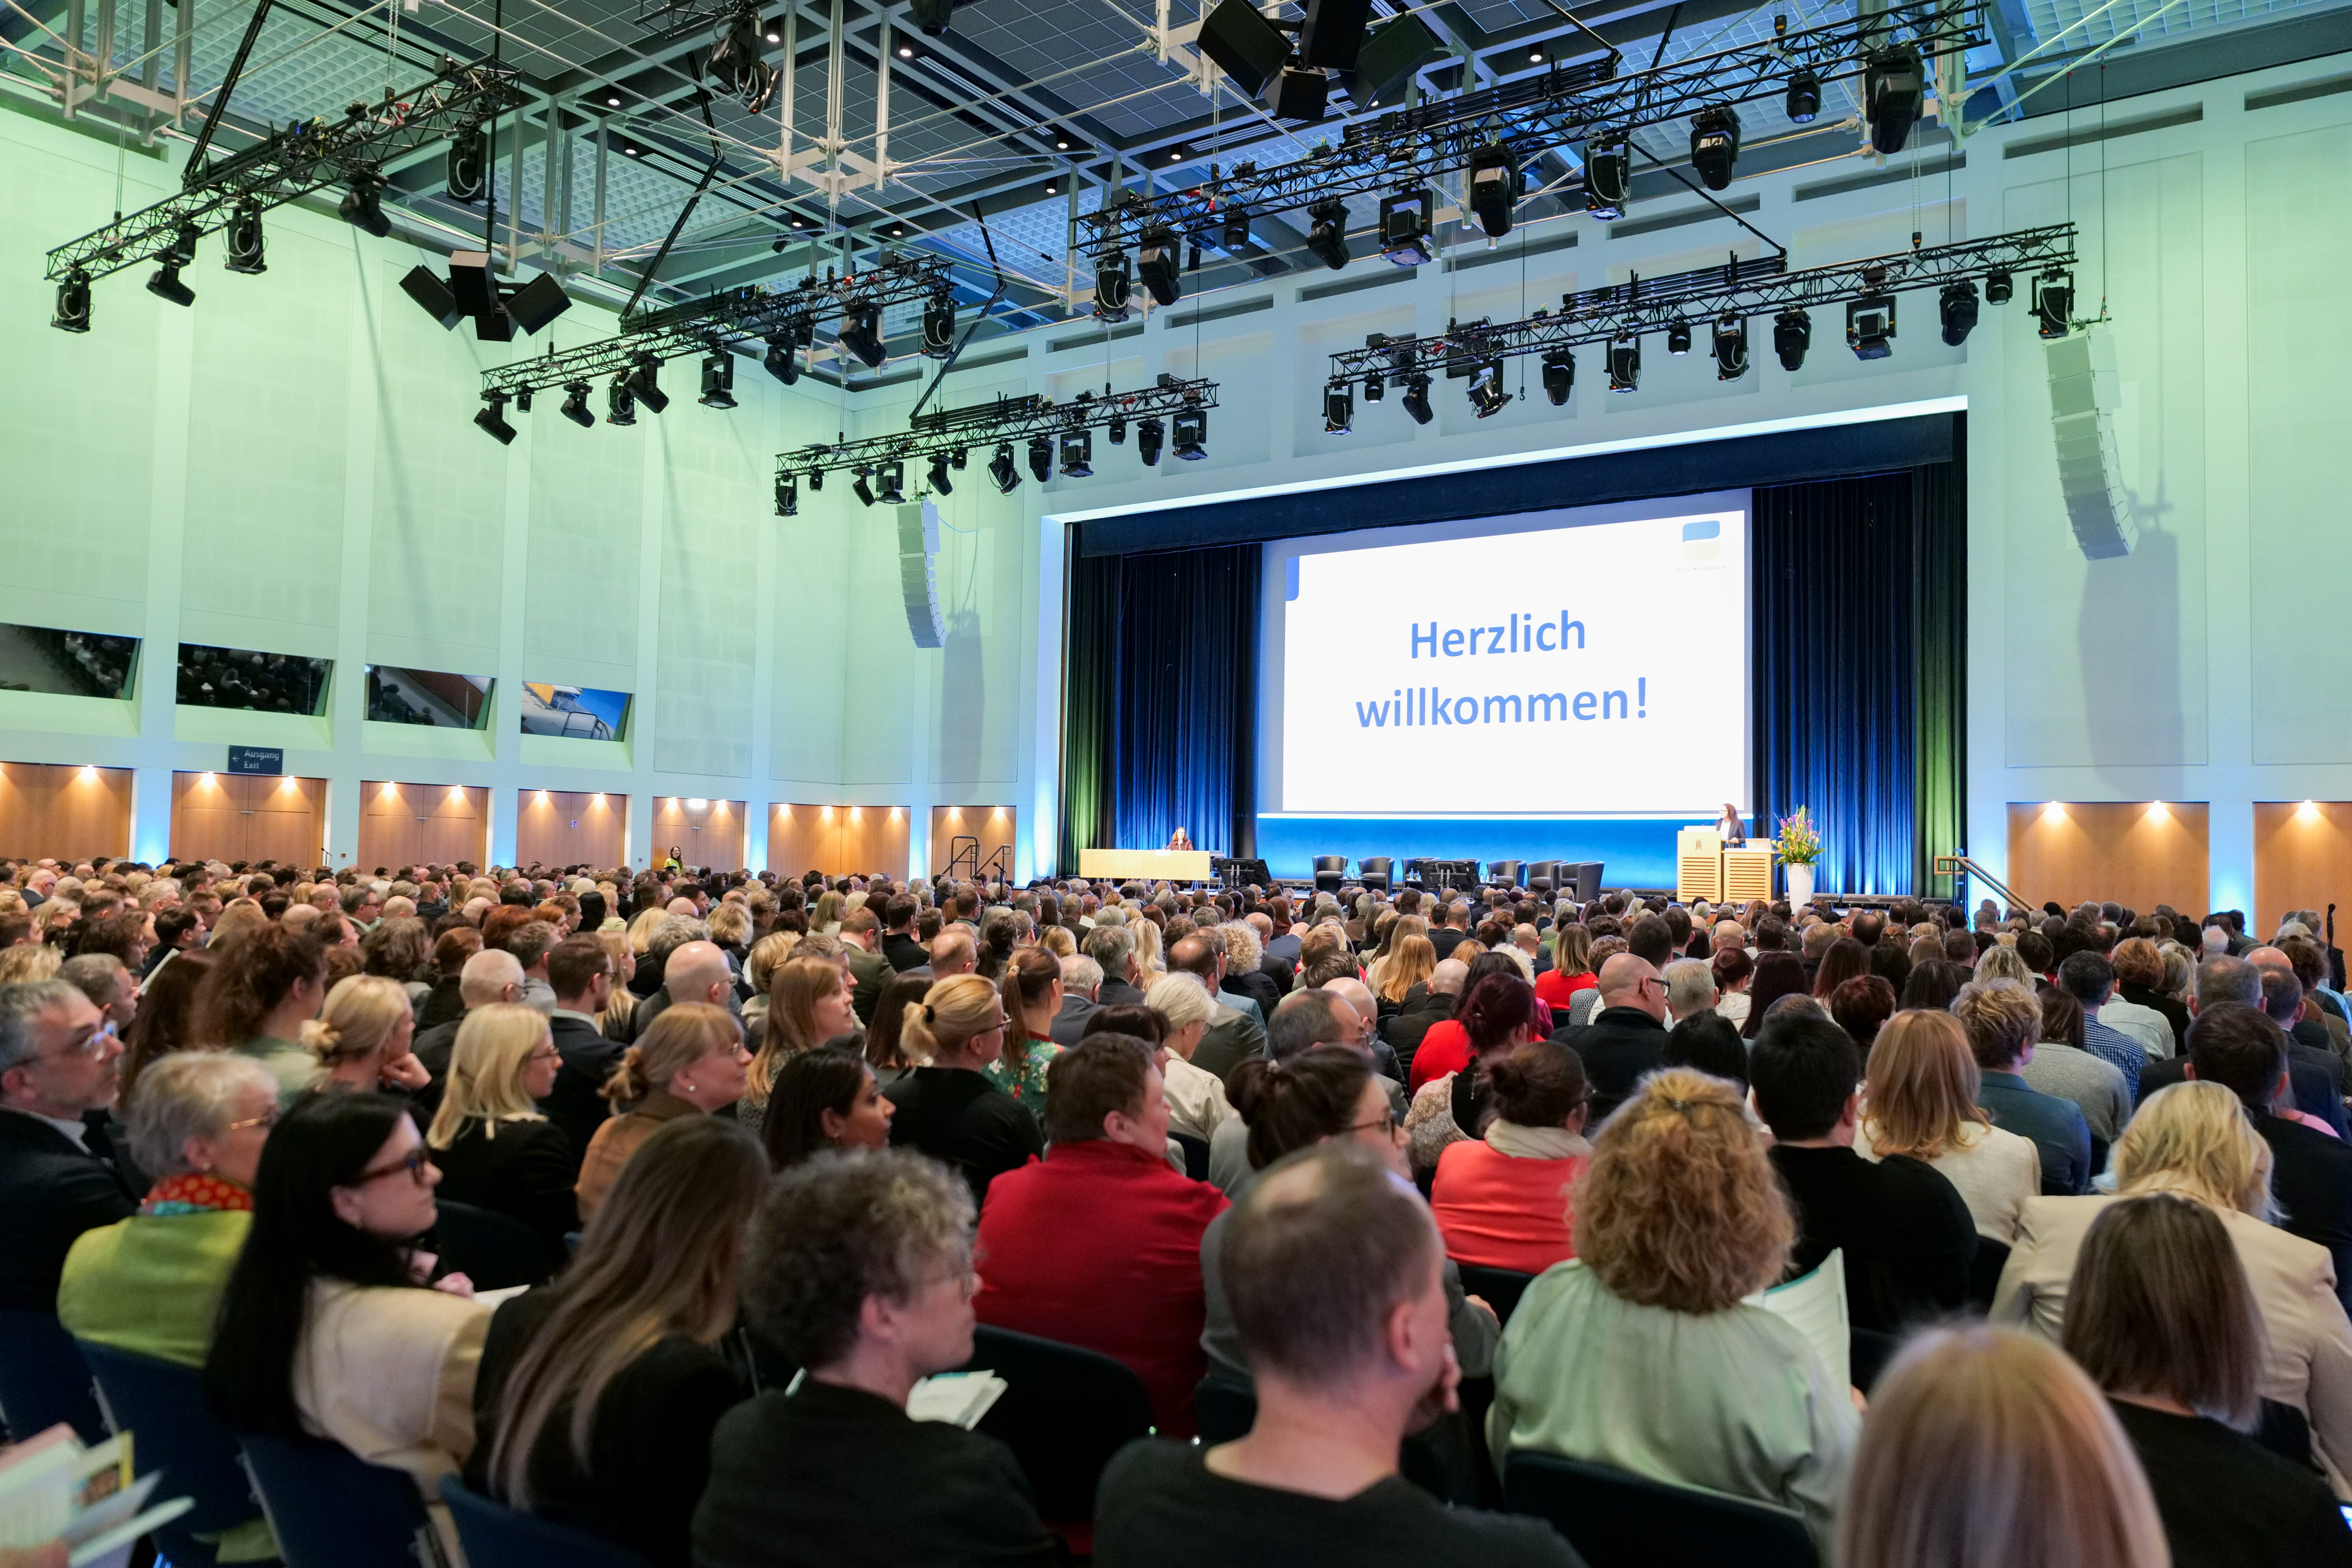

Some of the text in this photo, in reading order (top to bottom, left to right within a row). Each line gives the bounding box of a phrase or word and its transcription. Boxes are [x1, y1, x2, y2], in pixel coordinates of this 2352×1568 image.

[1411, 610, 1585, 659] Herzlich
[1356, 677, 1646, 728] willkommen!
[243, 761, 260, 769] Exit
[244, 750, 279, 761] Ausgang
